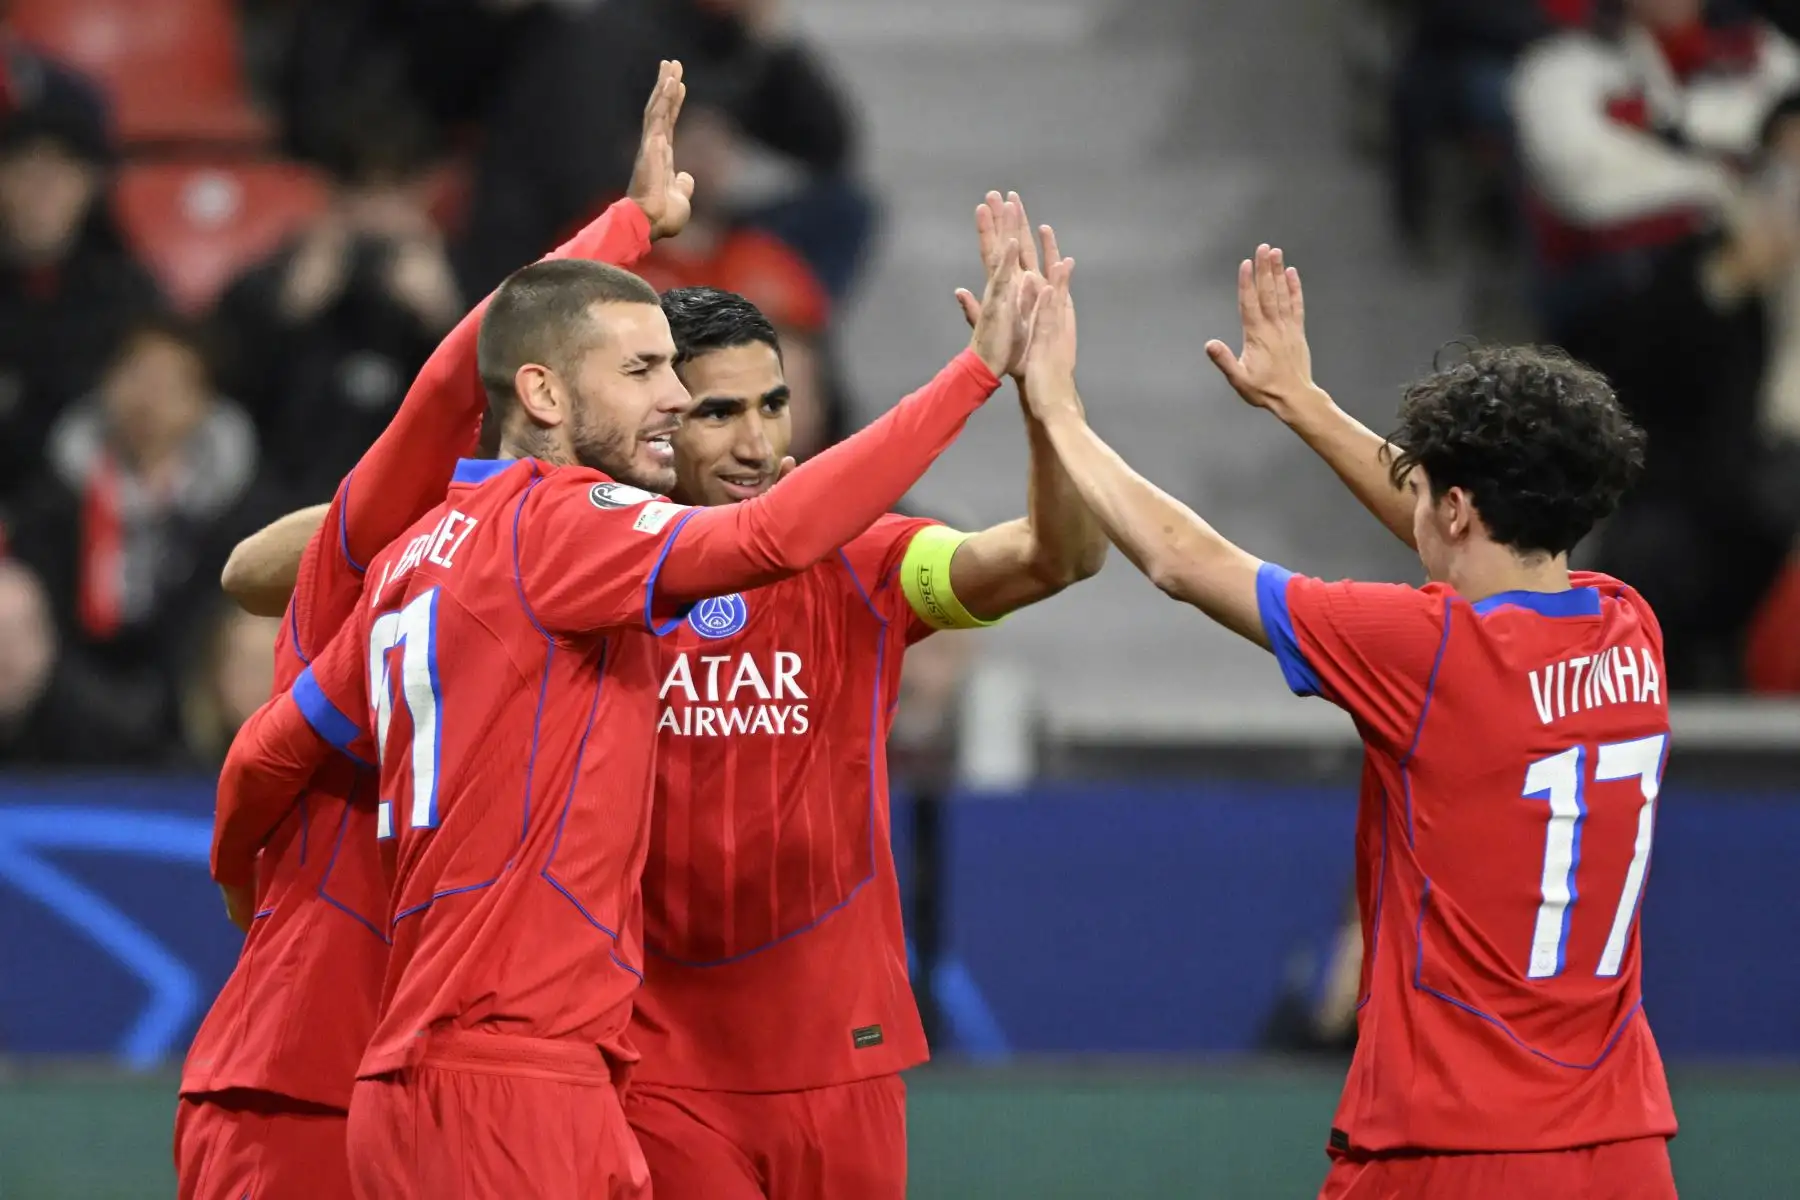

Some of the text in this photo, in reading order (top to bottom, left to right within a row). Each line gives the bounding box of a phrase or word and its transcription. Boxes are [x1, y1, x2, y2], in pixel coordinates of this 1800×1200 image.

[658, 652, 809, 702] ATAR
[1528, 646, 1661, 725] VITINHA
[657, 704, 809, 737] AIRWAYS
[1521, 731, 1671, 979] 17
